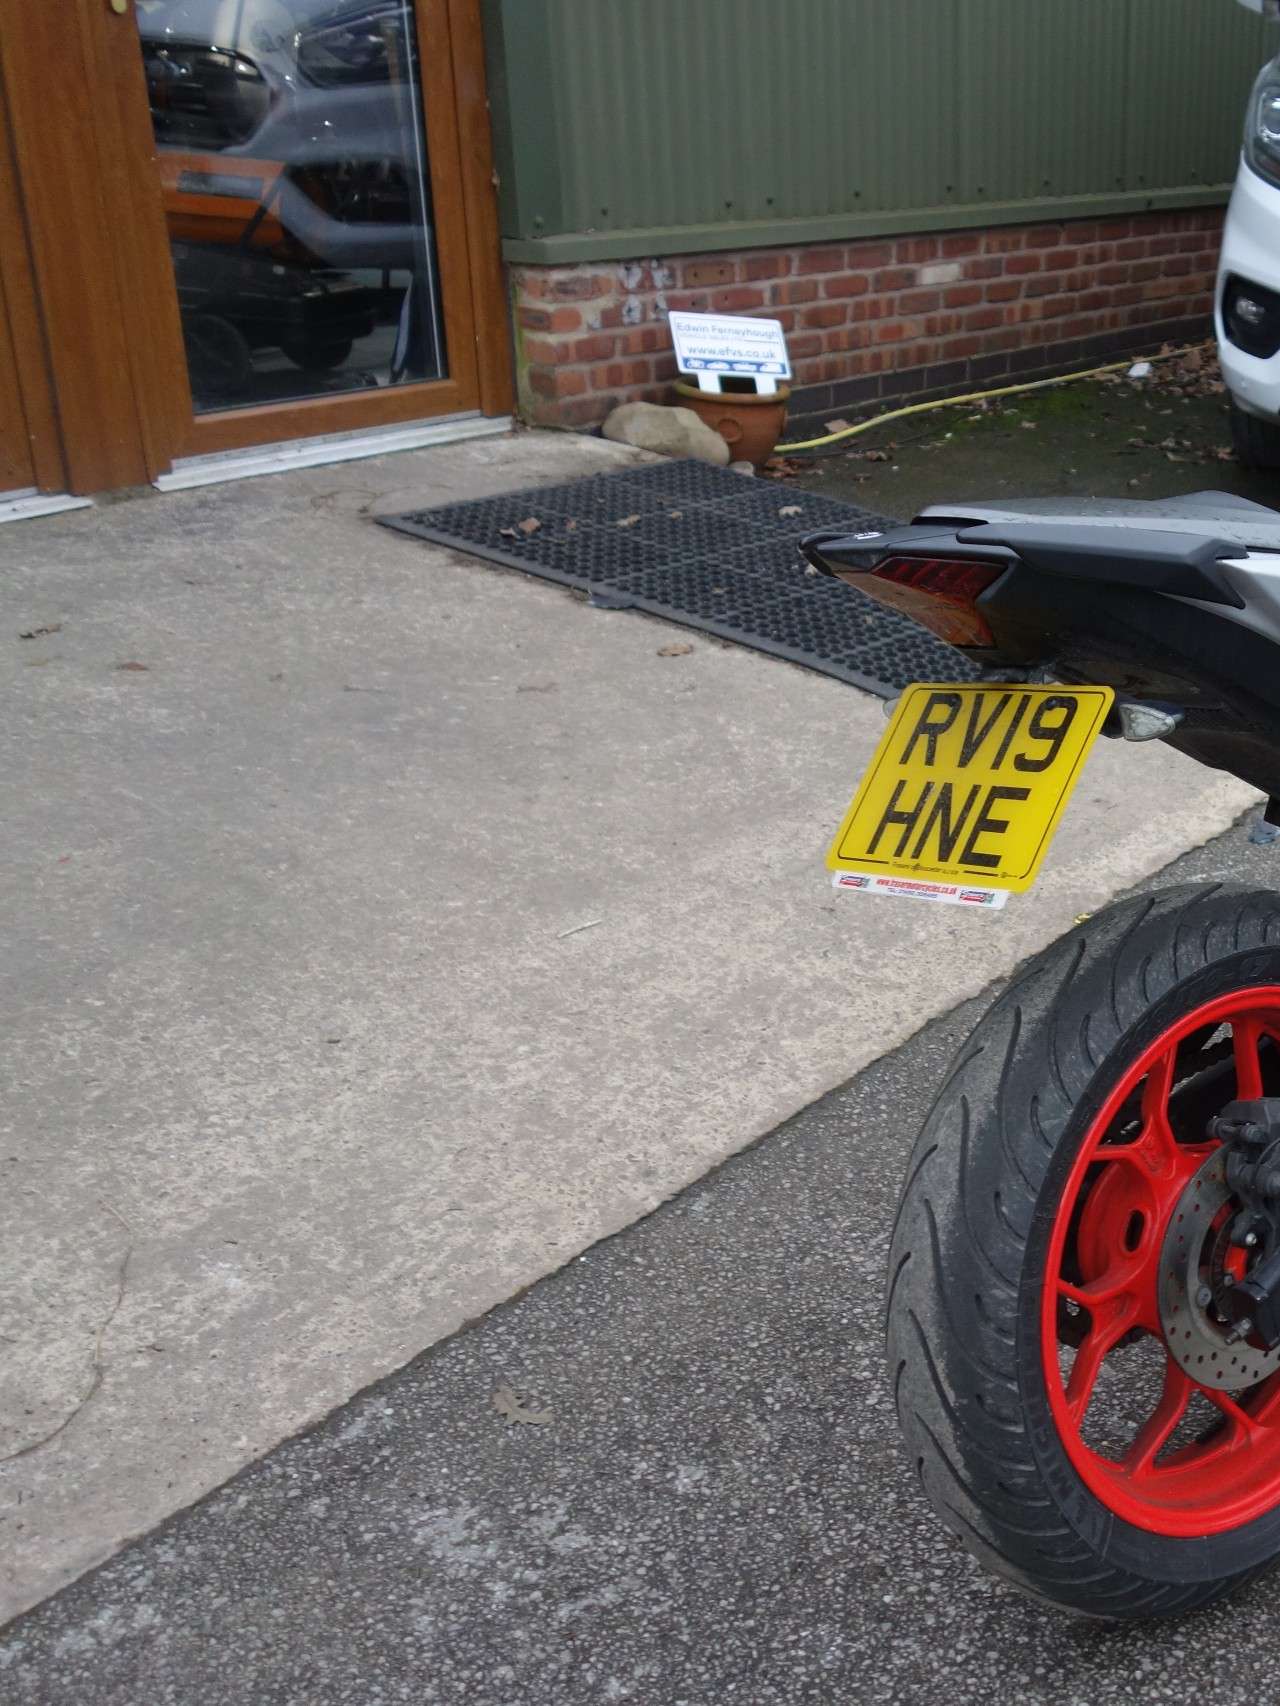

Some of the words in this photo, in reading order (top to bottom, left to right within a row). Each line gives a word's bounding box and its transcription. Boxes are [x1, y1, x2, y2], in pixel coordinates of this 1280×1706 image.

[676, 322, 709, 333] Edwin
[899, 692, 1078, 773] RV19
[865, 780, 1032, 868] HNE
